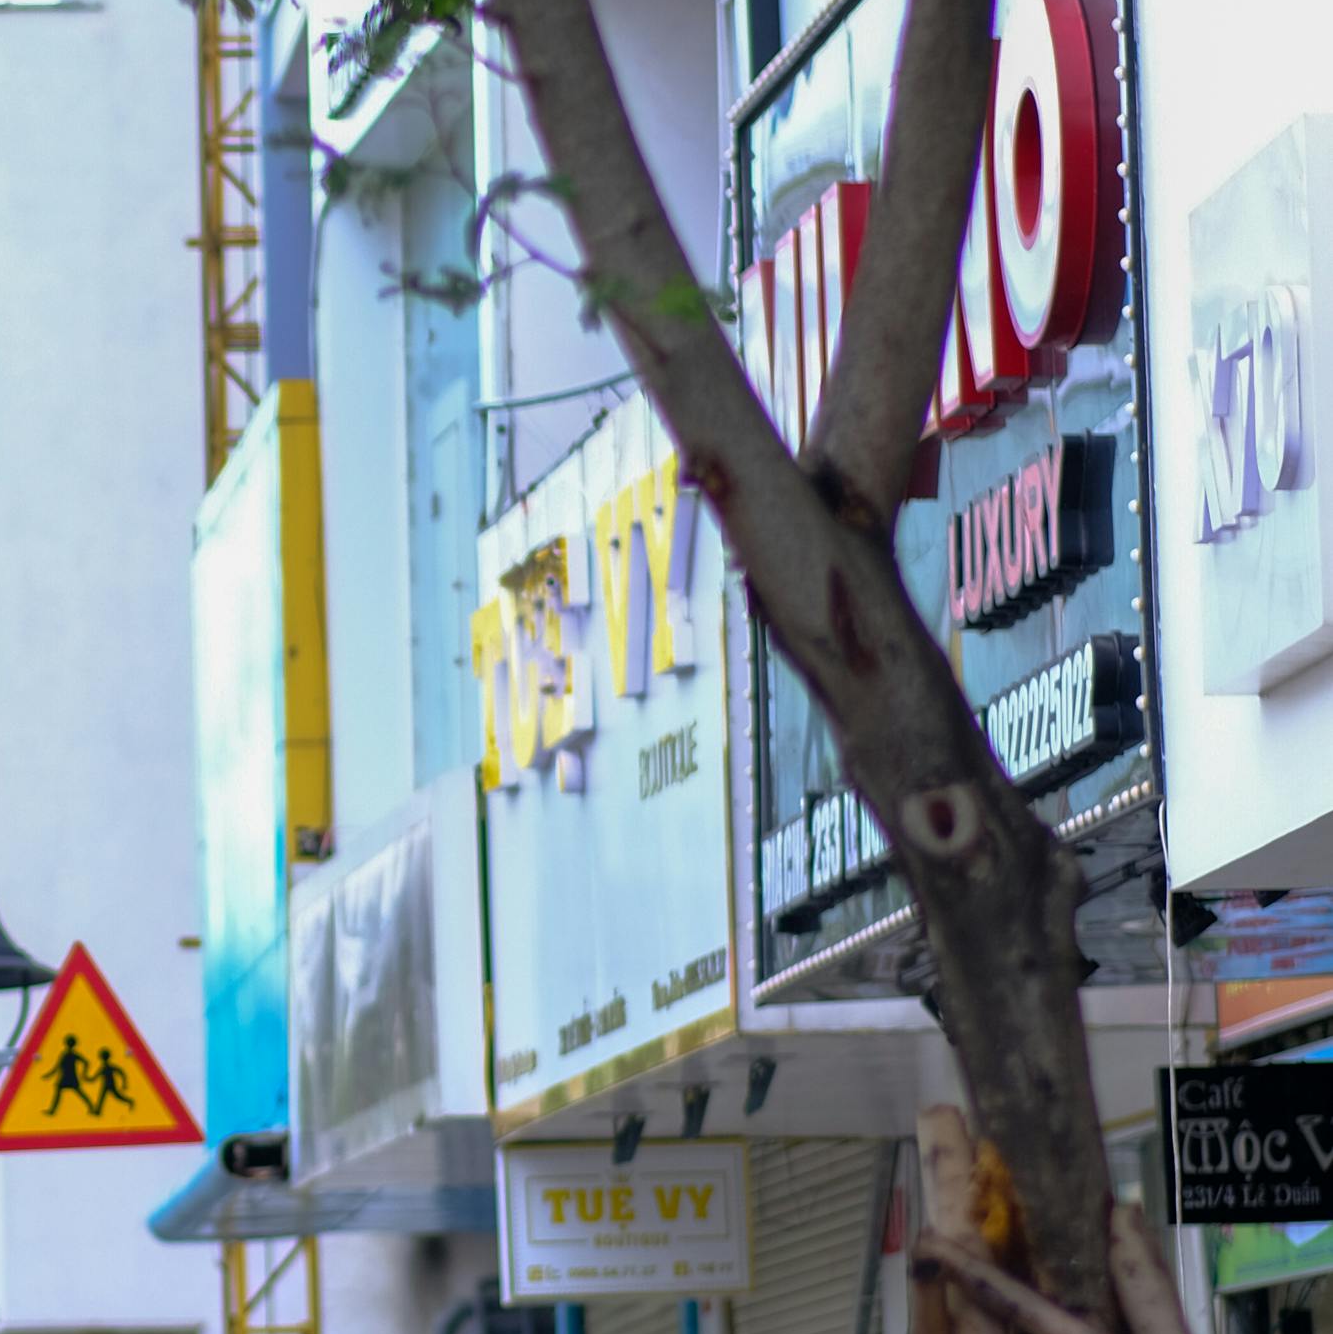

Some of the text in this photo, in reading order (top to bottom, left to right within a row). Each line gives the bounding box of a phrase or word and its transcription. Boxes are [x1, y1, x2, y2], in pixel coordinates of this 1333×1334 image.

[949, 437, 1064, 623] LUXURY
[812, 794, 841, 888] 233
[1178, 1076, 1244, 1111] Café
[654, 1183, 714, 1221] VY
